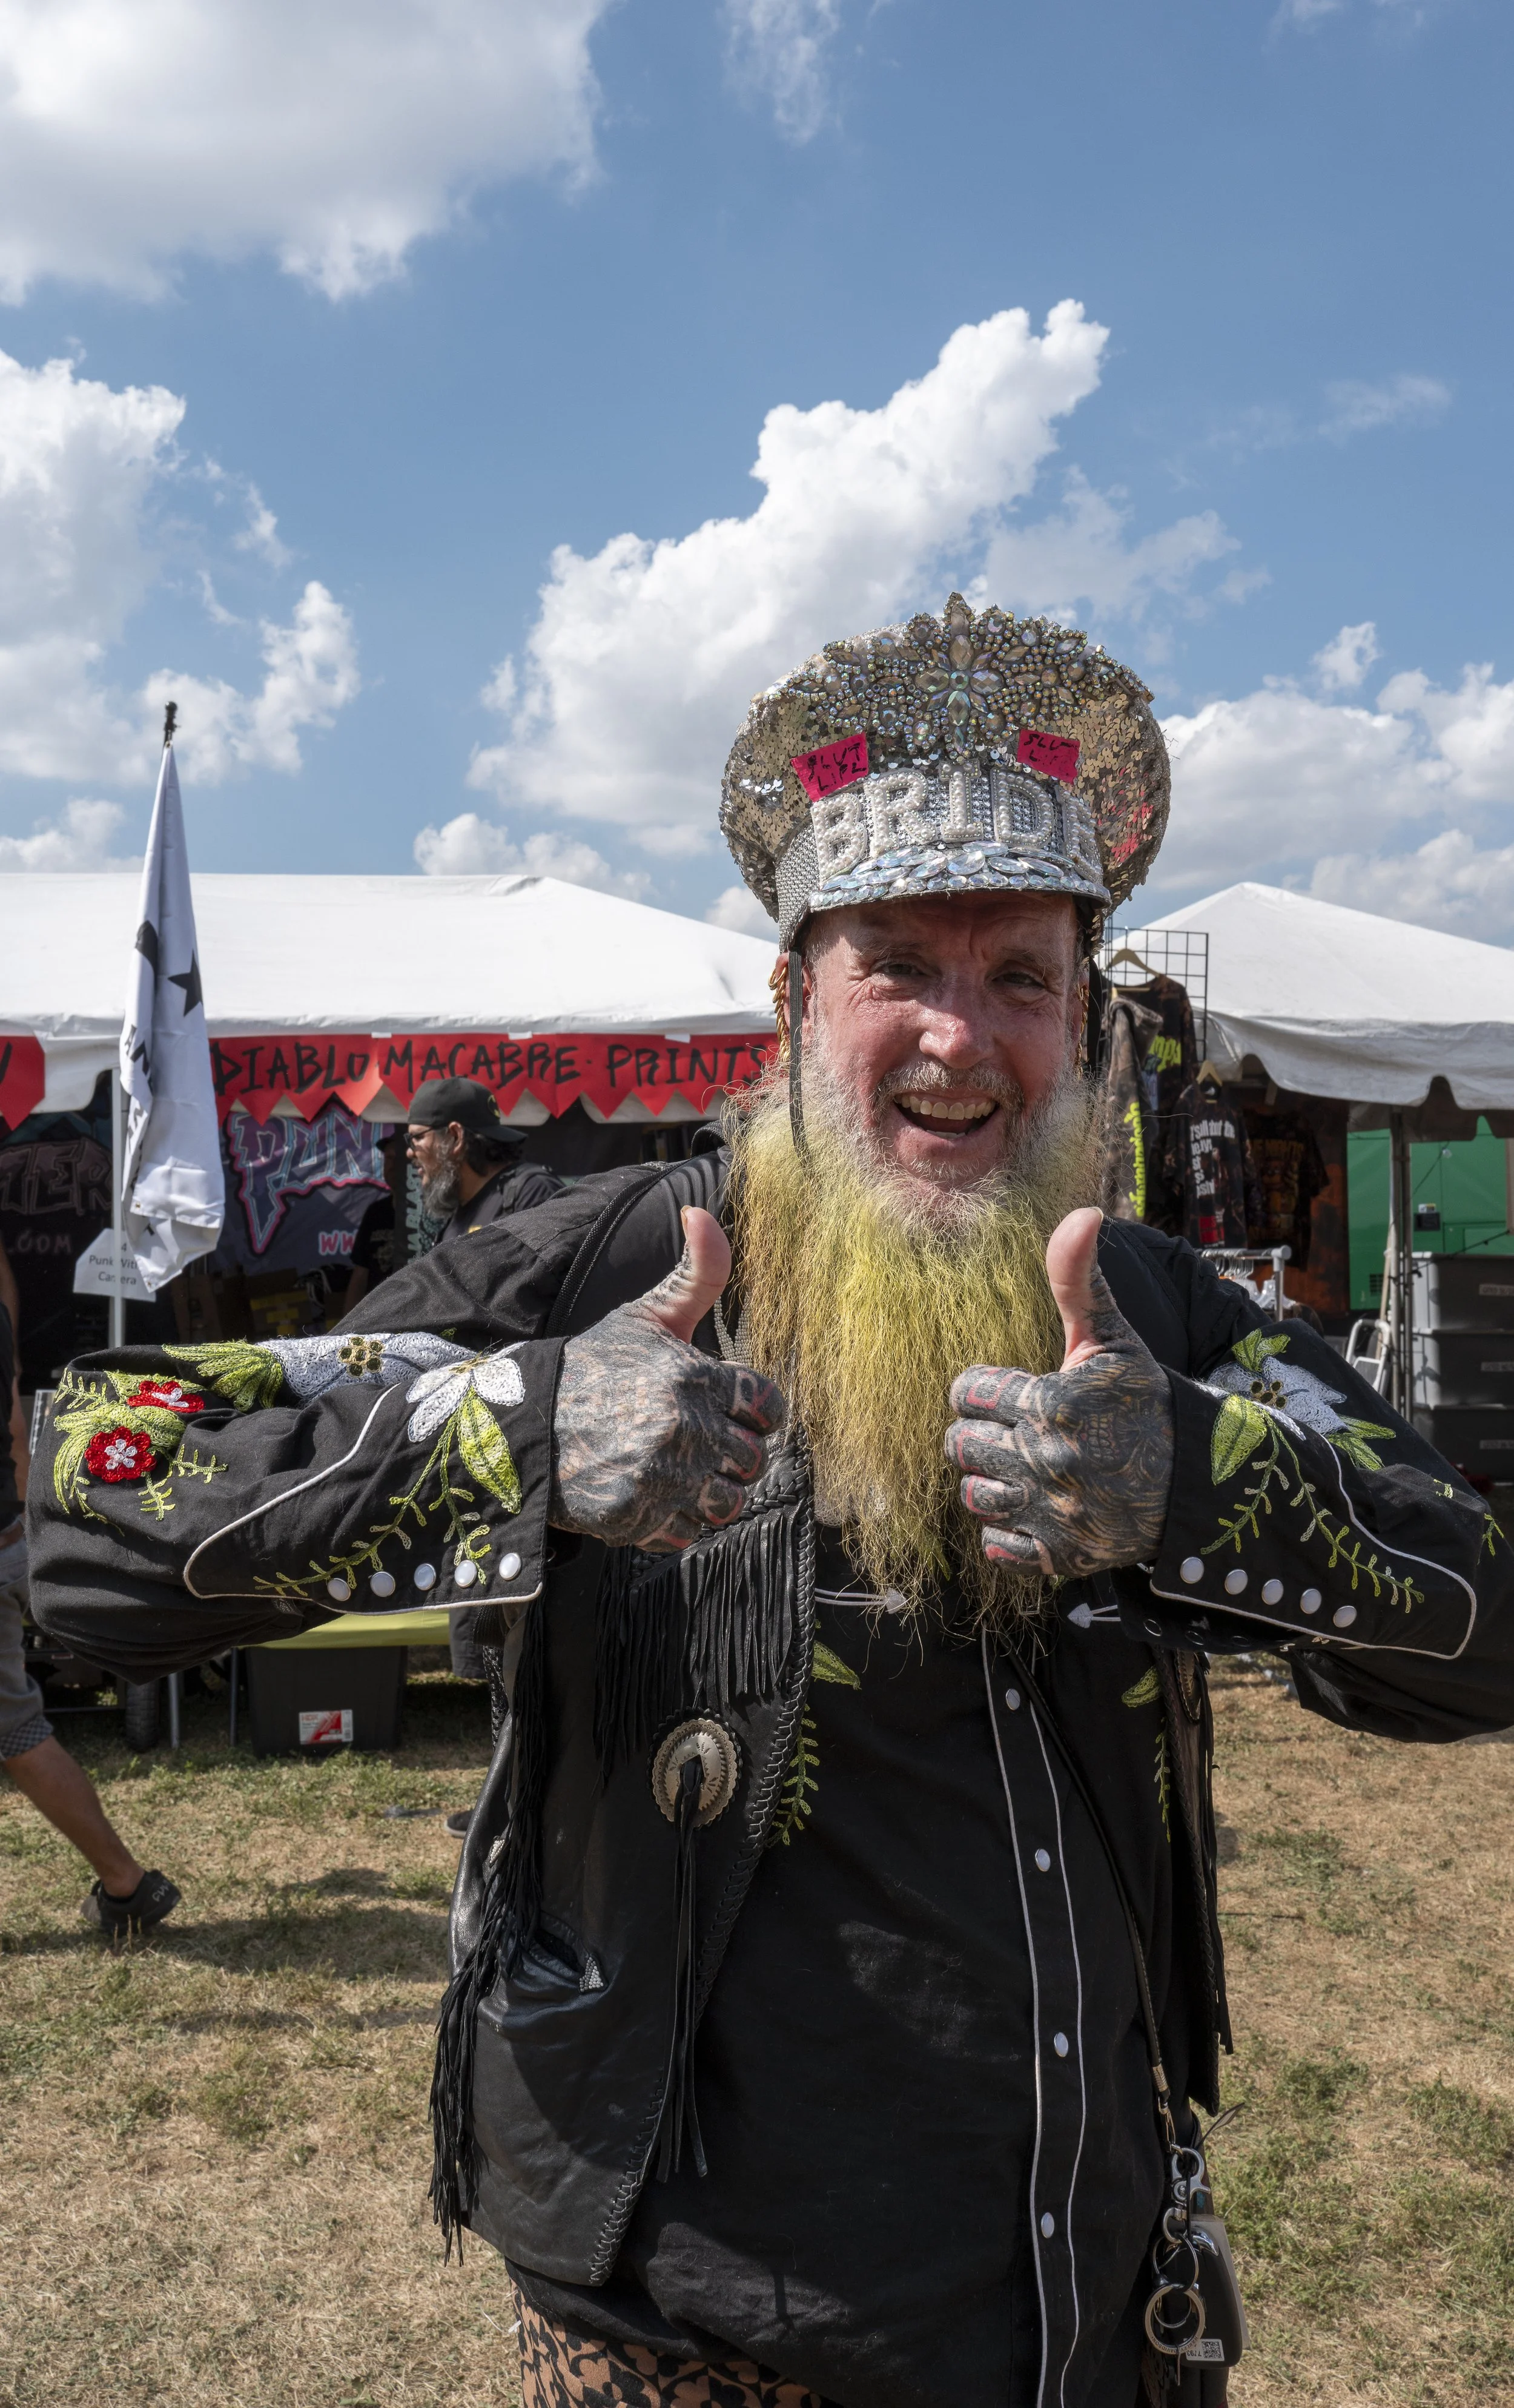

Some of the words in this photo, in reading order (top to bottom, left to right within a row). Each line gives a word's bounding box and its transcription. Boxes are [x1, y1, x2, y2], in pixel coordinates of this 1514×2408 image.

[810, 759, 1103, 888] BRIDE
[209, 1041, 371, 1097] DIABLO
[383, 1039, 581, 1093] MACABRE
[606, 1044, 767, 1089] PRINTS
[88, 1255, 114, 1266] Punk
